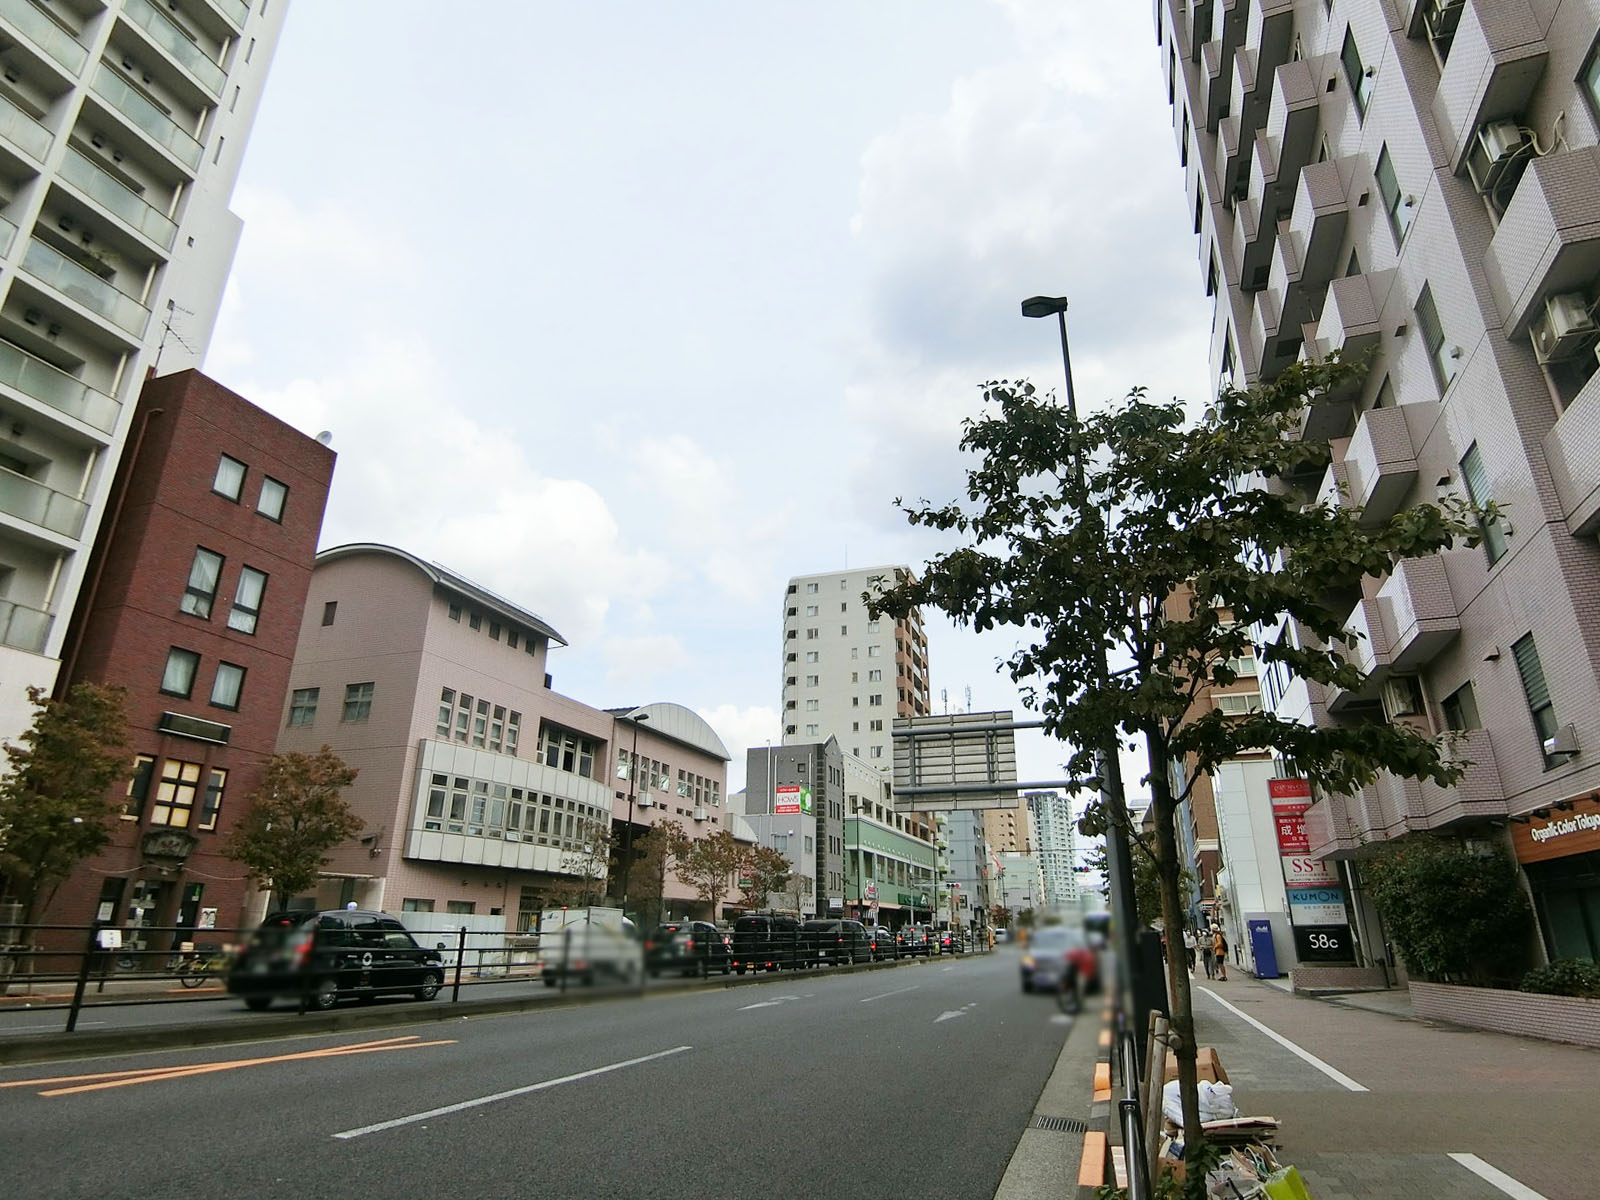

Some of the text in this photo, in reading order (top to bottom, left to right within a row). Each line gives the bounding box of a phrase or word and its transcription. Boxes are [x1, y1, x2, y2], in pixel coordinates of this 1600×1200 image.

[1557, 818, 1577, 835] Color
[1574, 814, 1600, 831] Tokyo
[1292, 890, 1339, 902] KUMON
